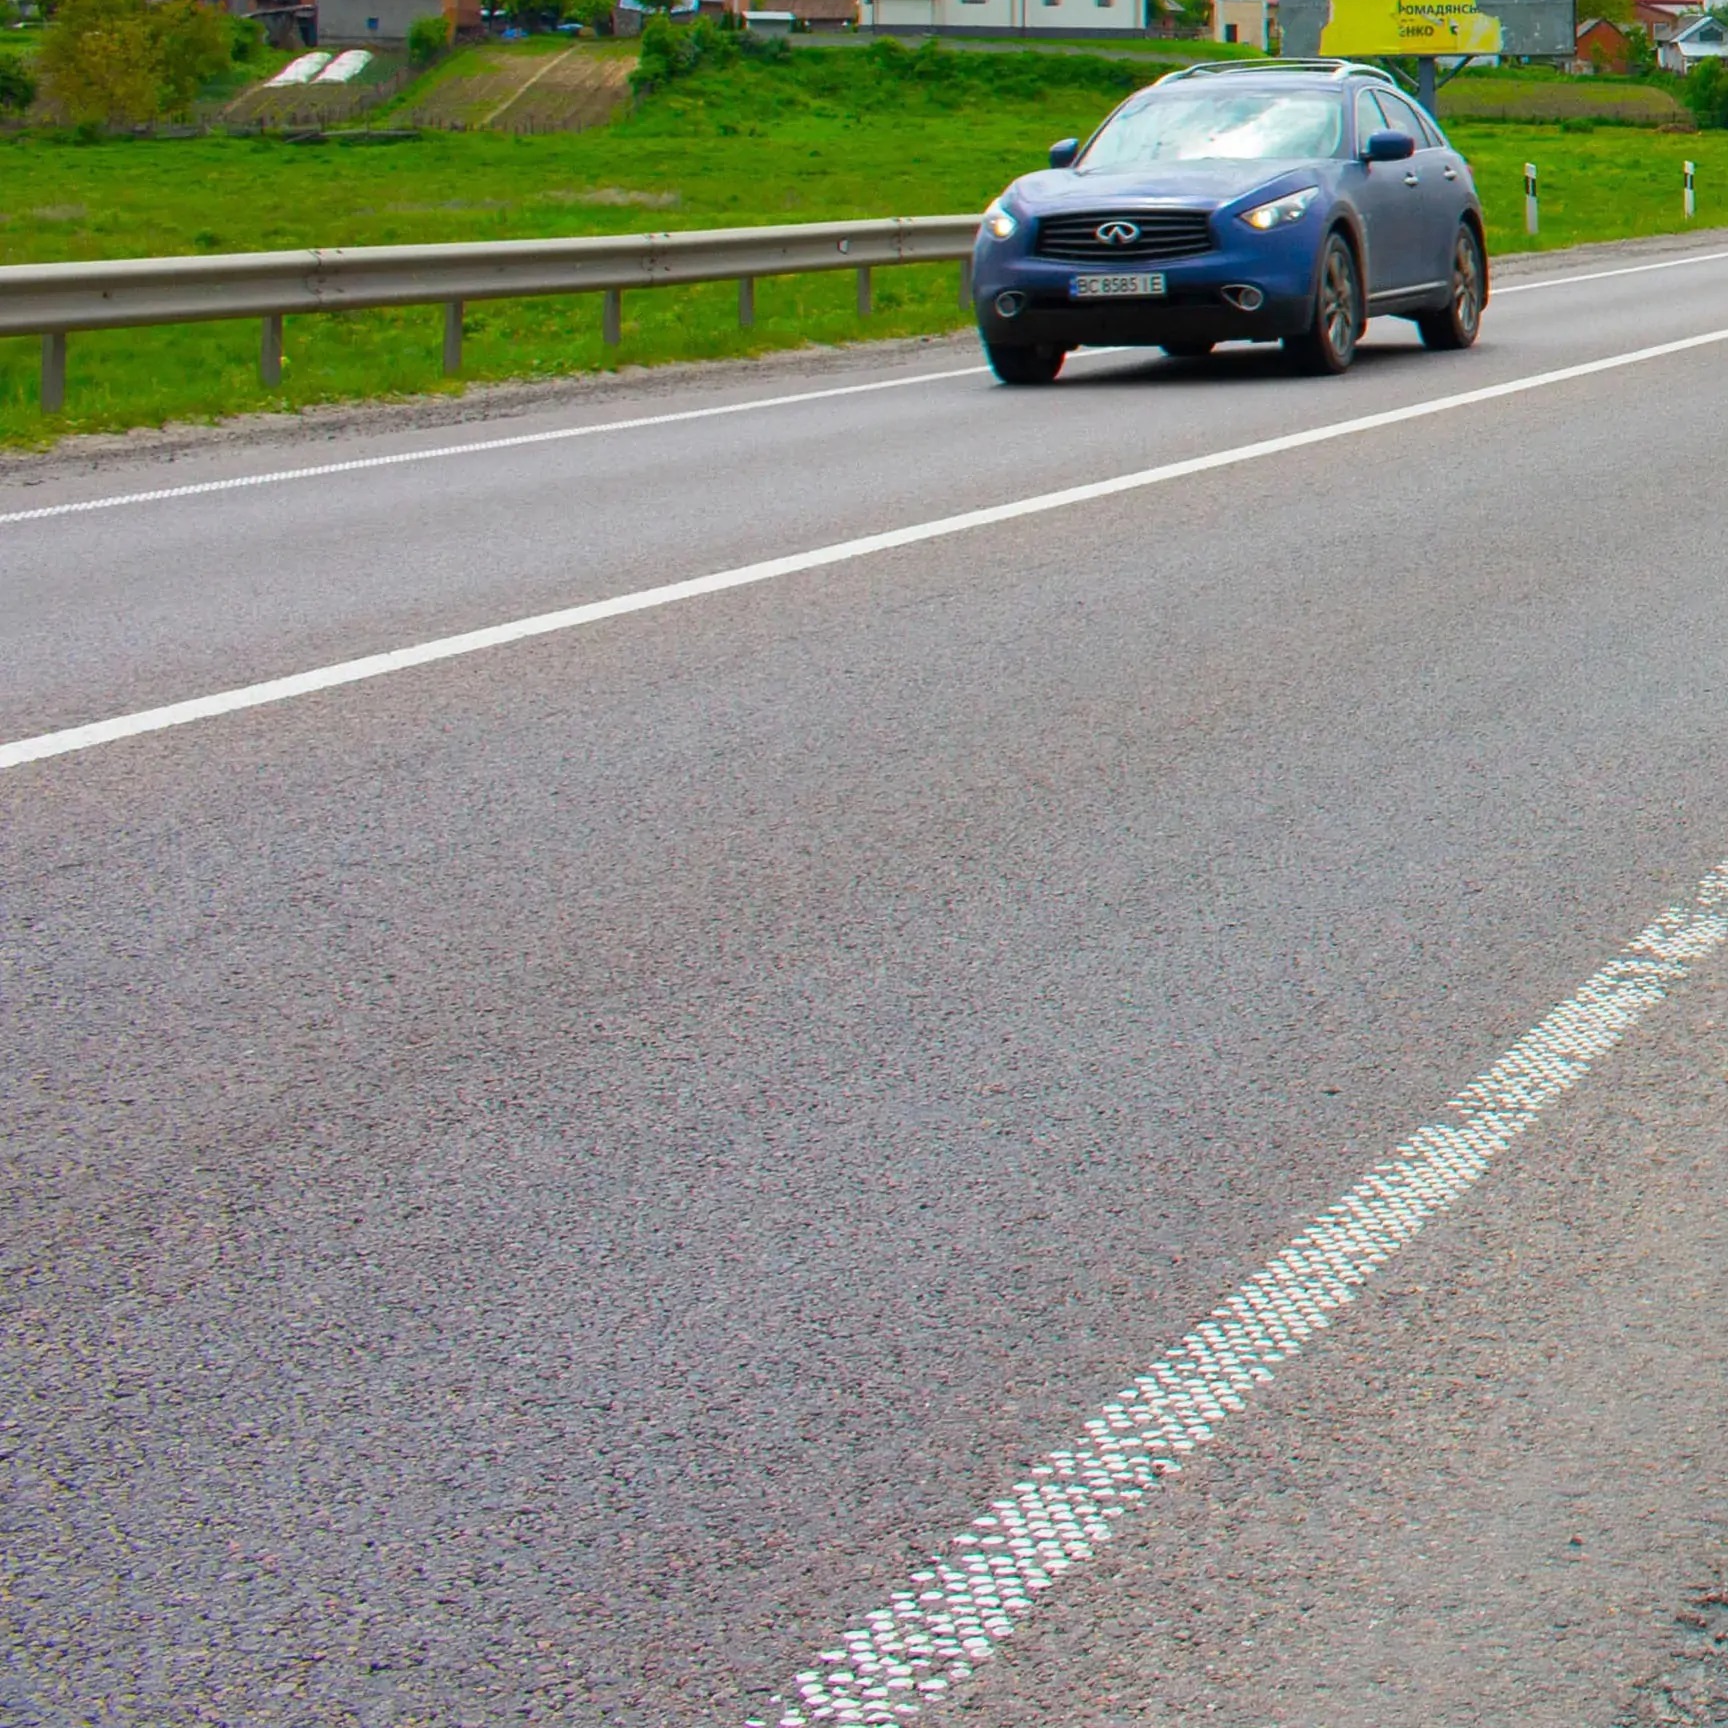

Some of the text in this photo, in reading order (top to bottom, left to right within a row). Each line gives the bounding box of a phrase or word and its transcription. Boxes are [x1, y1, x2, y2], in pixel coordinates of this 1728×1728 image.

[1077, 275, 1163, 293] BC 8585 IE
